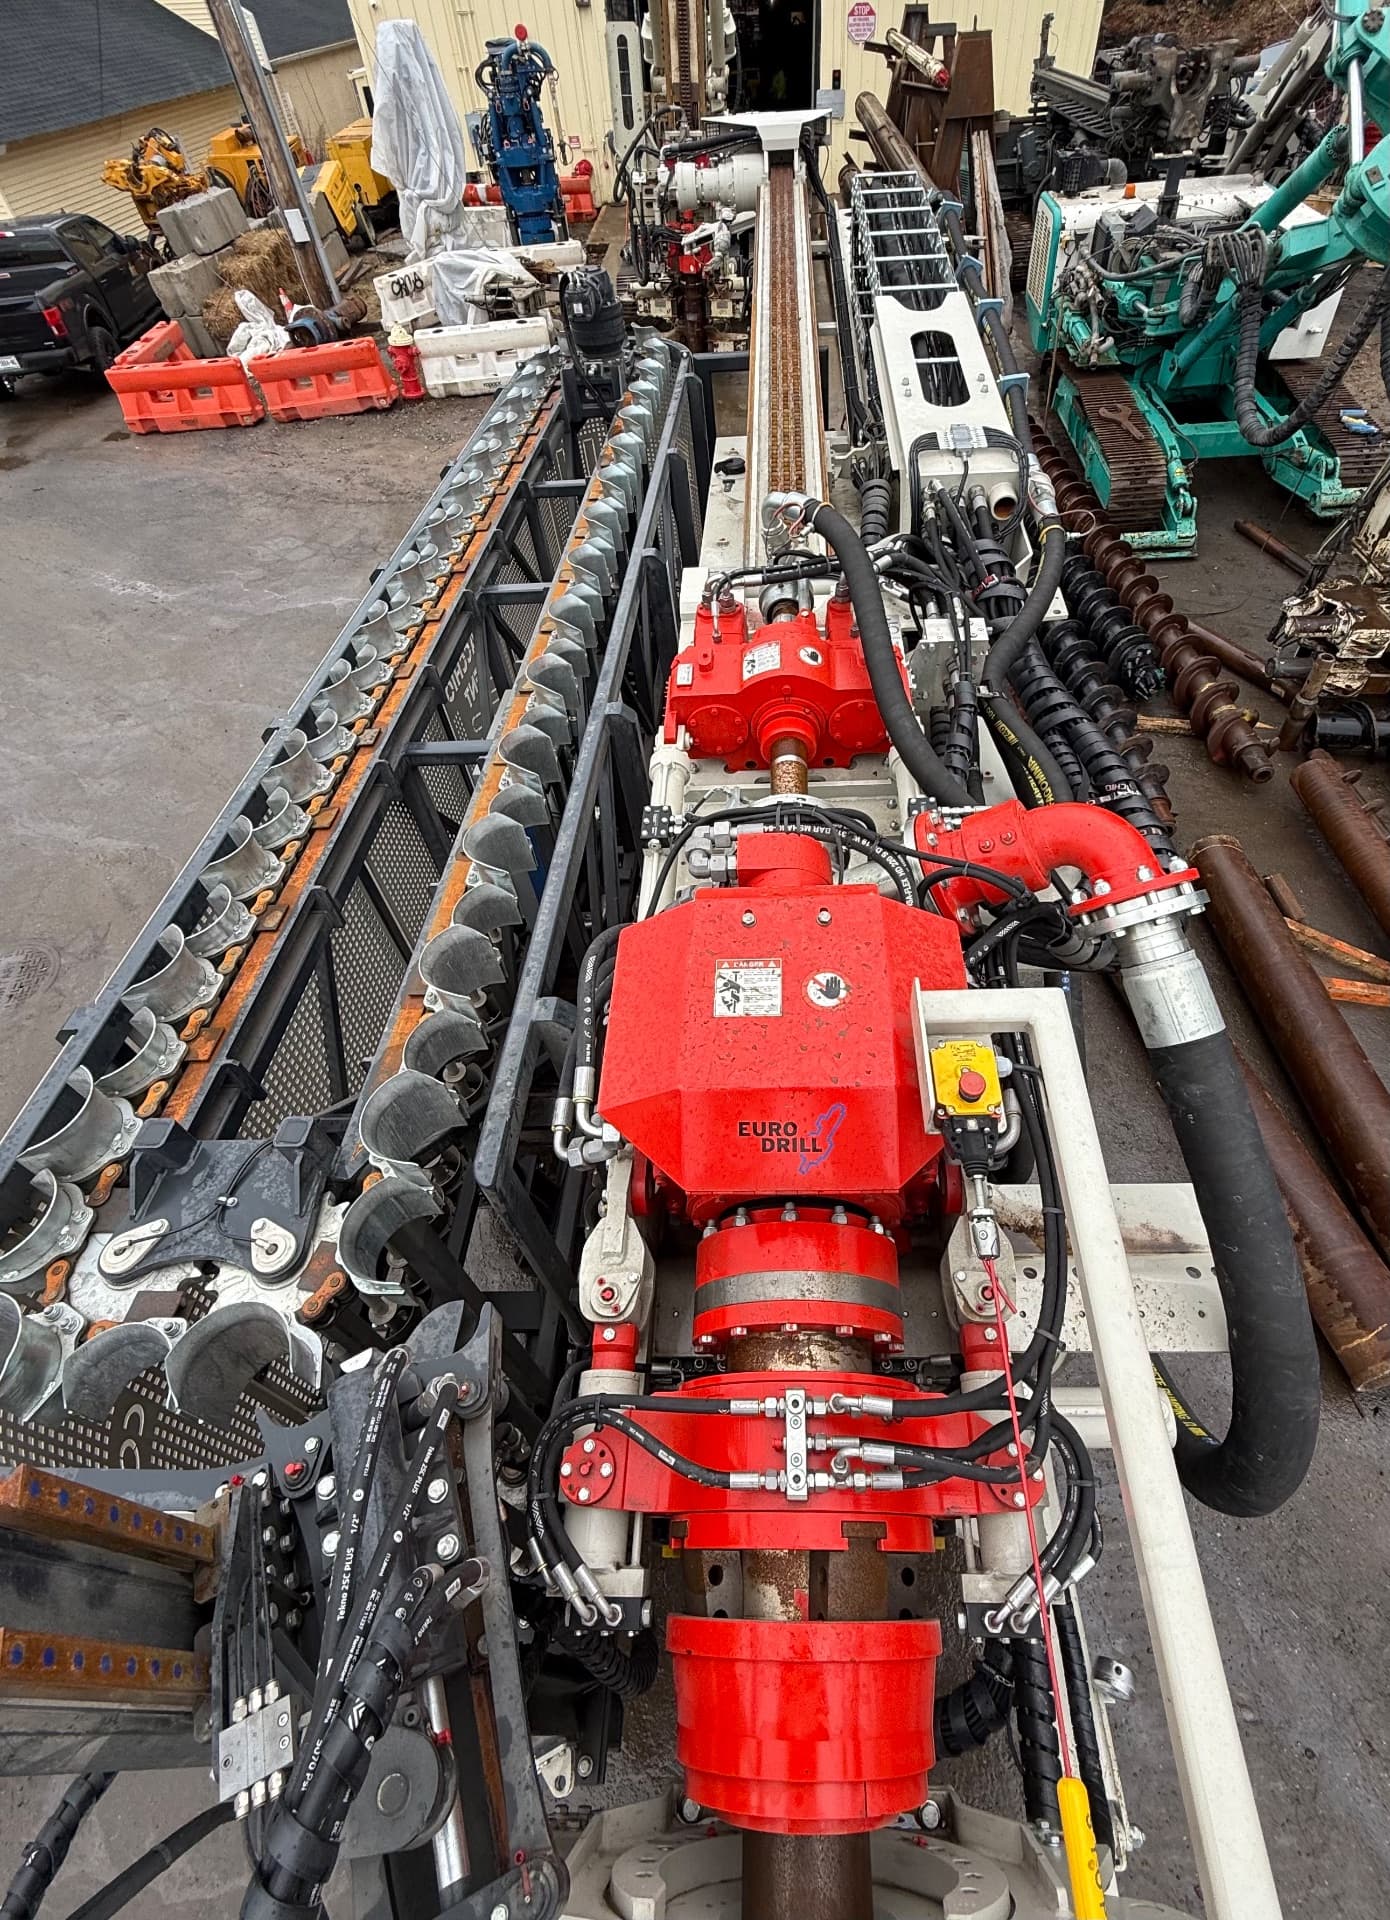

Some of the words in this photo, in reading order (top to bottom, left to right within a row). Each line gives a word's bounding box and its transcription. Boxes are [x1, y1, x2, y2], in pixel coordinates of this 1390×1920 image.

[853, 5, 870, 16] STOP
[738, 1121, 798, 1137] EURO
[761, 1137, 823, 1153] DRILL
[344, 1547, 355, 1571] PLUS
